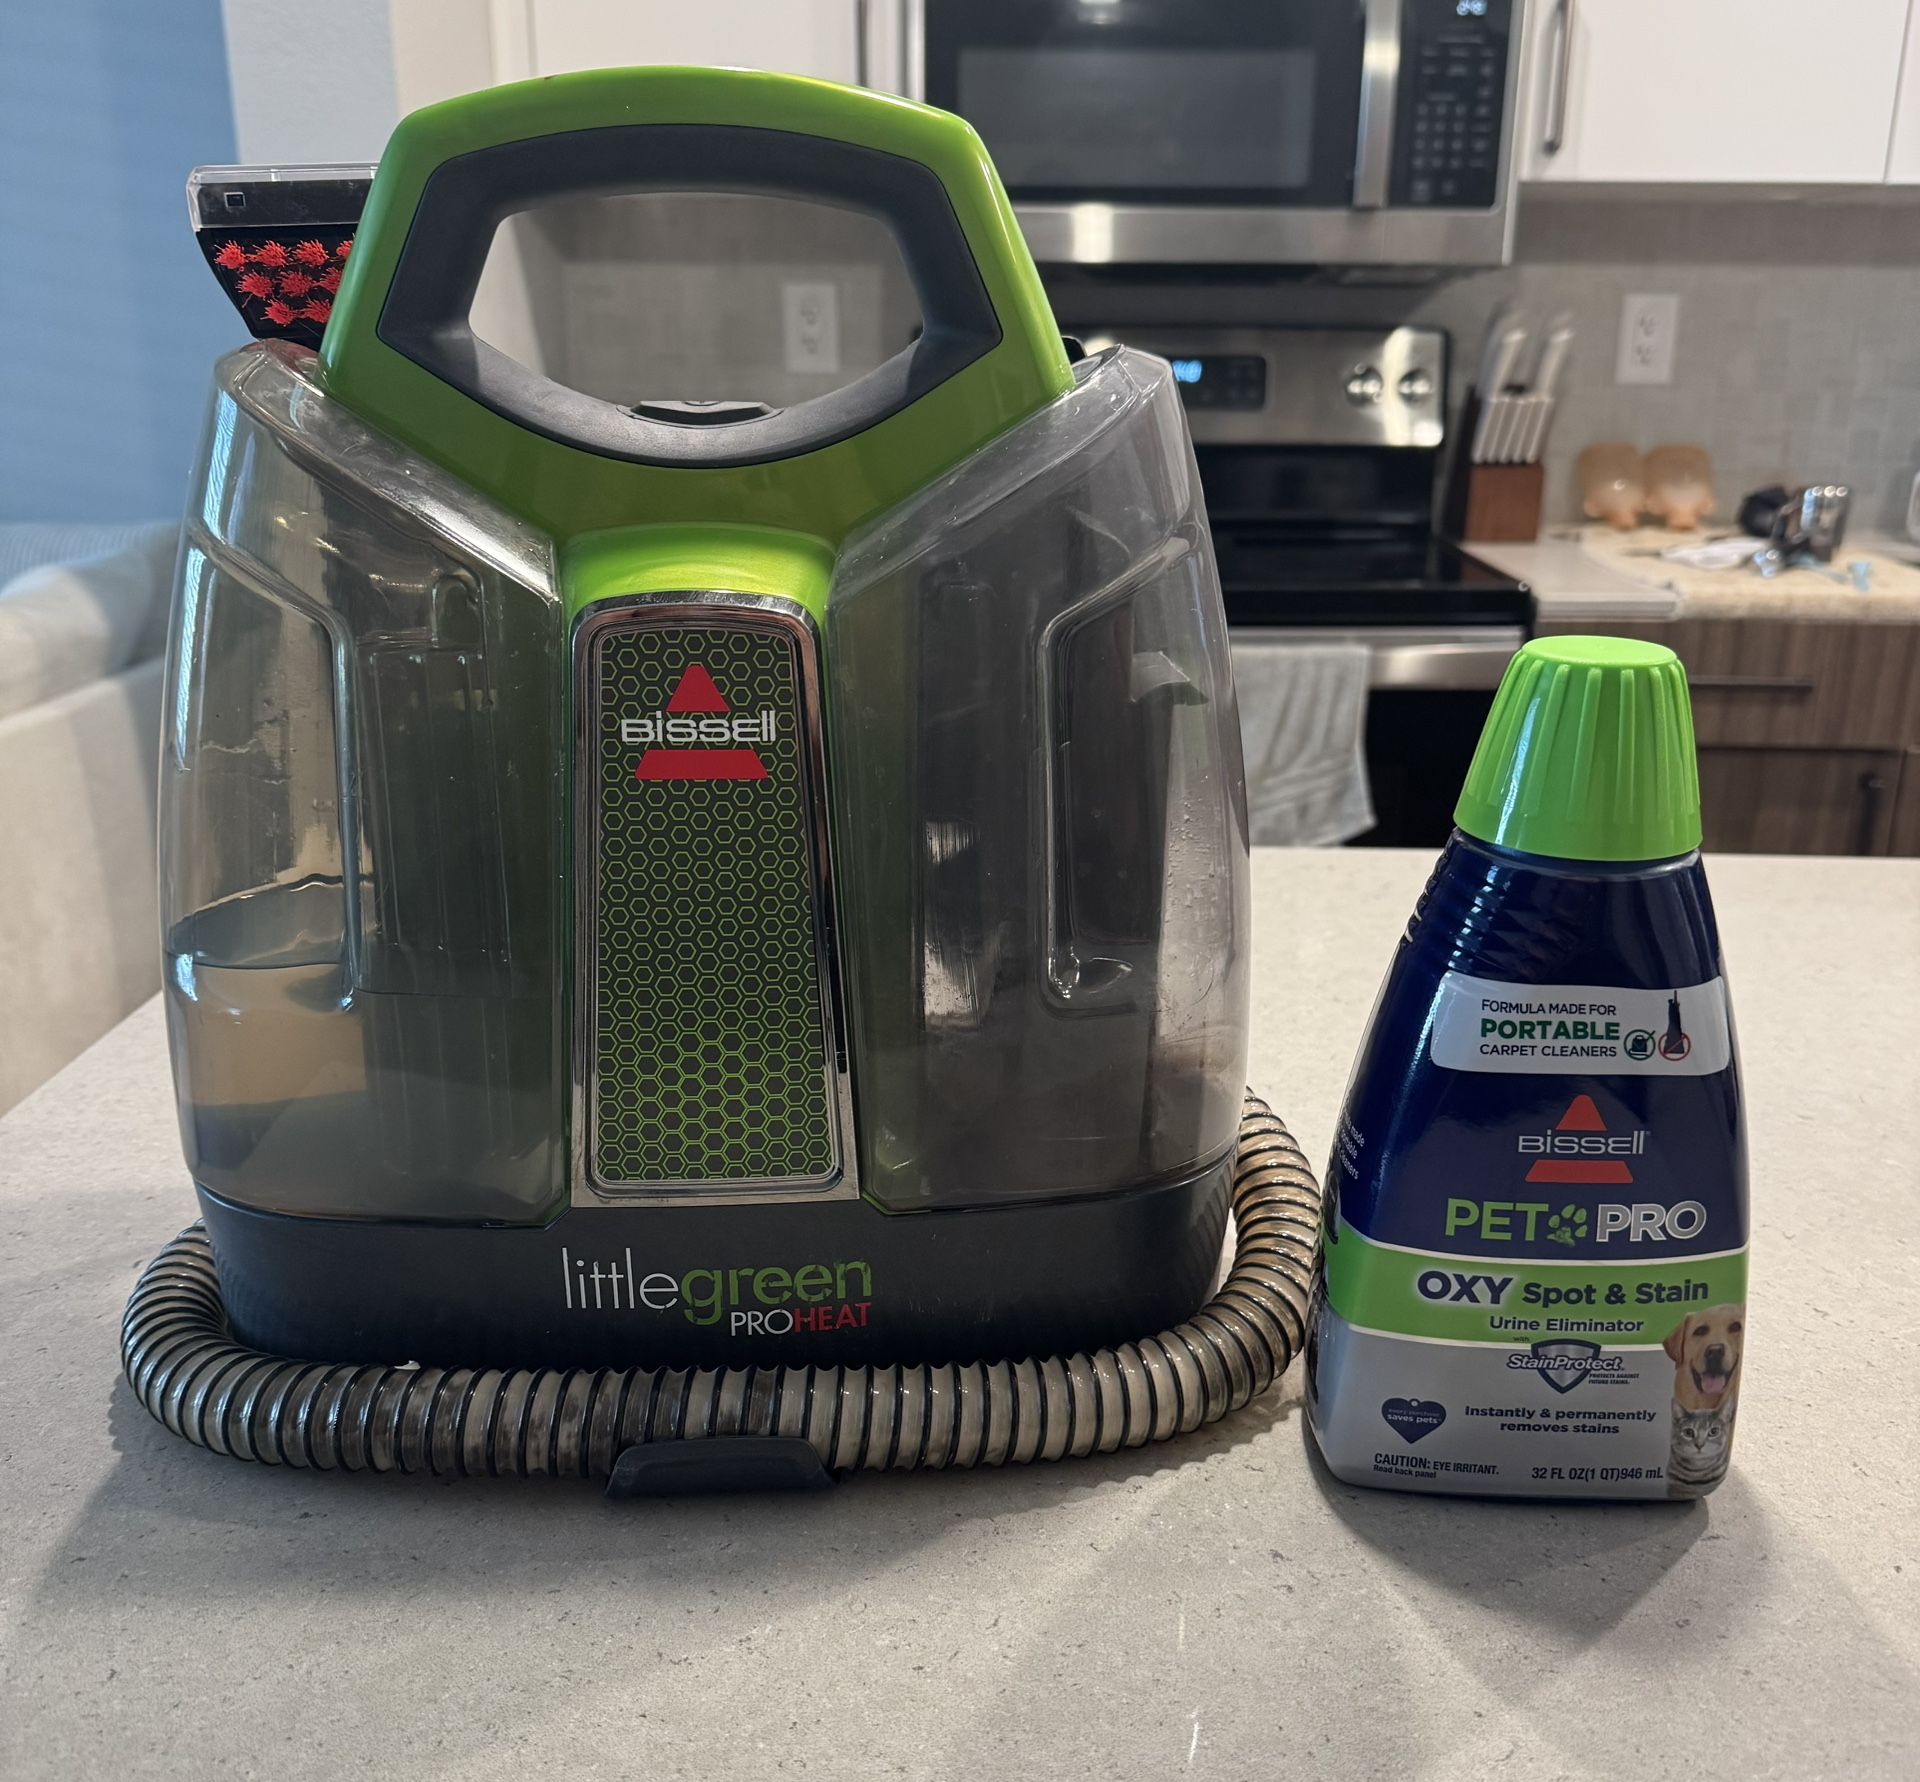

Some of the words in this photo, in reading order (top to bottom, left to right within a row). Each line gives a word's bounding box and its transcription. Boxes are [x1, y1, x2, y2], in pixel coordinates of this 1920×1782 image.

[1481, 999, 1546, 1014] FORMULA
[1549, 1003, 1587, 1015] MADE
[1589, 1004, 1617, 1016] FOR
[1480, 1018, 1620, 1040] PORTABLE
[1480, 1044, 1538, 1056] CARPET
[1541, 1045, 1617, 1057] CLEANERS
[1444, 1197, 1550, 1241] PET
[1595, 1200, 1707, 1243] PRO
[1417, 1270, 1514, 1305] OXY
[1522, 1282, 1596, 1308] Spot
[1604, 1283, 1627, 1306] &
[1634, 1279, 1709, 1305] Stain
[1490, 1316, 1540, 1331] Urine
[1546, 1318, 1644, 1332] Eliminator
[1387, 1413, 1414, 1422] saves
[1465, 1406, 1536, 1419] Instantly
[1539, 1408, 1551, 1419] &
[1555, 1409, 1657, 1422] permanently
[1500, 1422, 1569, 1433] removes
[1572, 1423, 1620, 1434] stains
[1373, 1464, 1393, 1474] Read
[1394, 1467, 1414, 1477] back
[1415, 1470, 1437, 1479] panel
[1374, 1453, 1431, 1469] CAUTION:
[1433, 1461, 1452, 1472] EYE
[1453, 1462, 1500, 1475] IRRITANT.
[1531, 1467, 1547, 1480] 32
[1550, 1467, 1565, 1480] FL
[1645, 1467, 1664, 1479] mL
